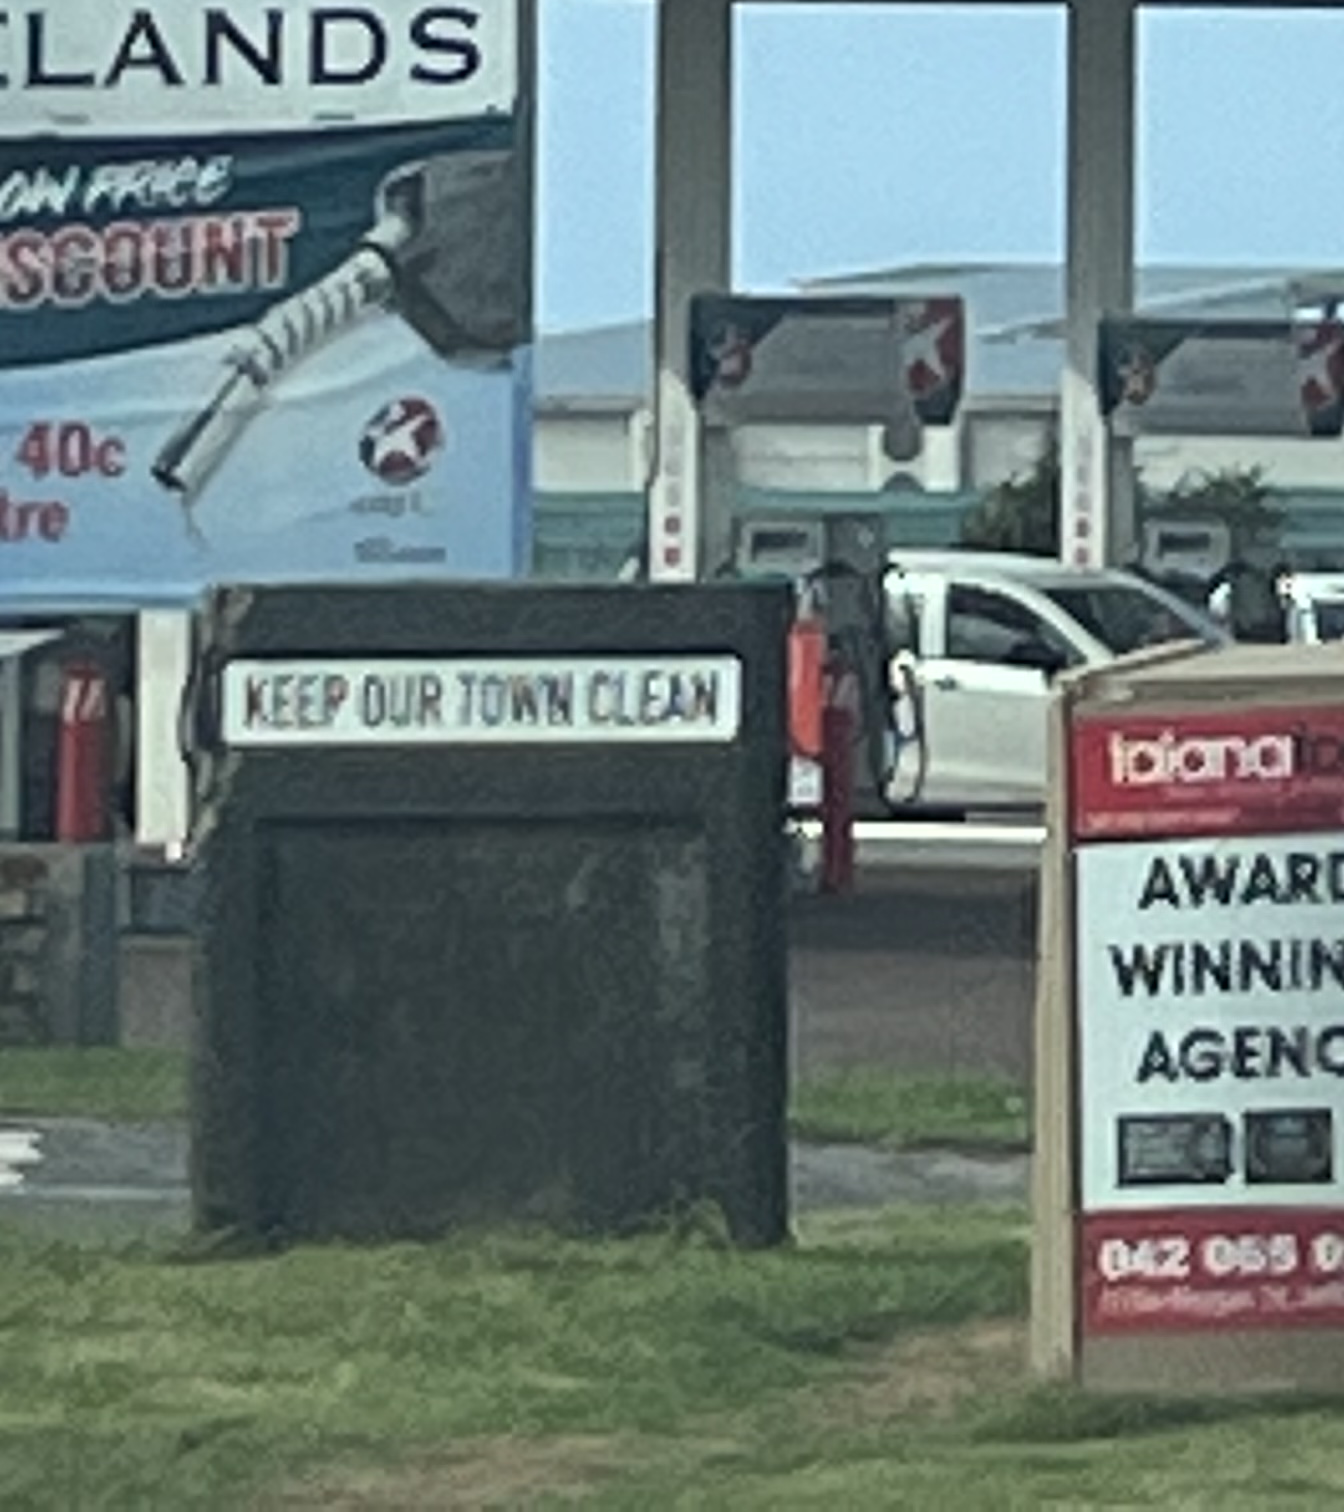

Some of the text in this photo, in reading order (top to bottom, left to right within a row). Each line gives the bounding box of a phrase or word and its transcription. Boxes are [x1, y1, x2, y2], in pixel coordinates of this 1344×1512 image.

[0, 8, 483, 88] LANDS
[243, 670, 720, 729] KEEP OUR TOWN CLEAN
